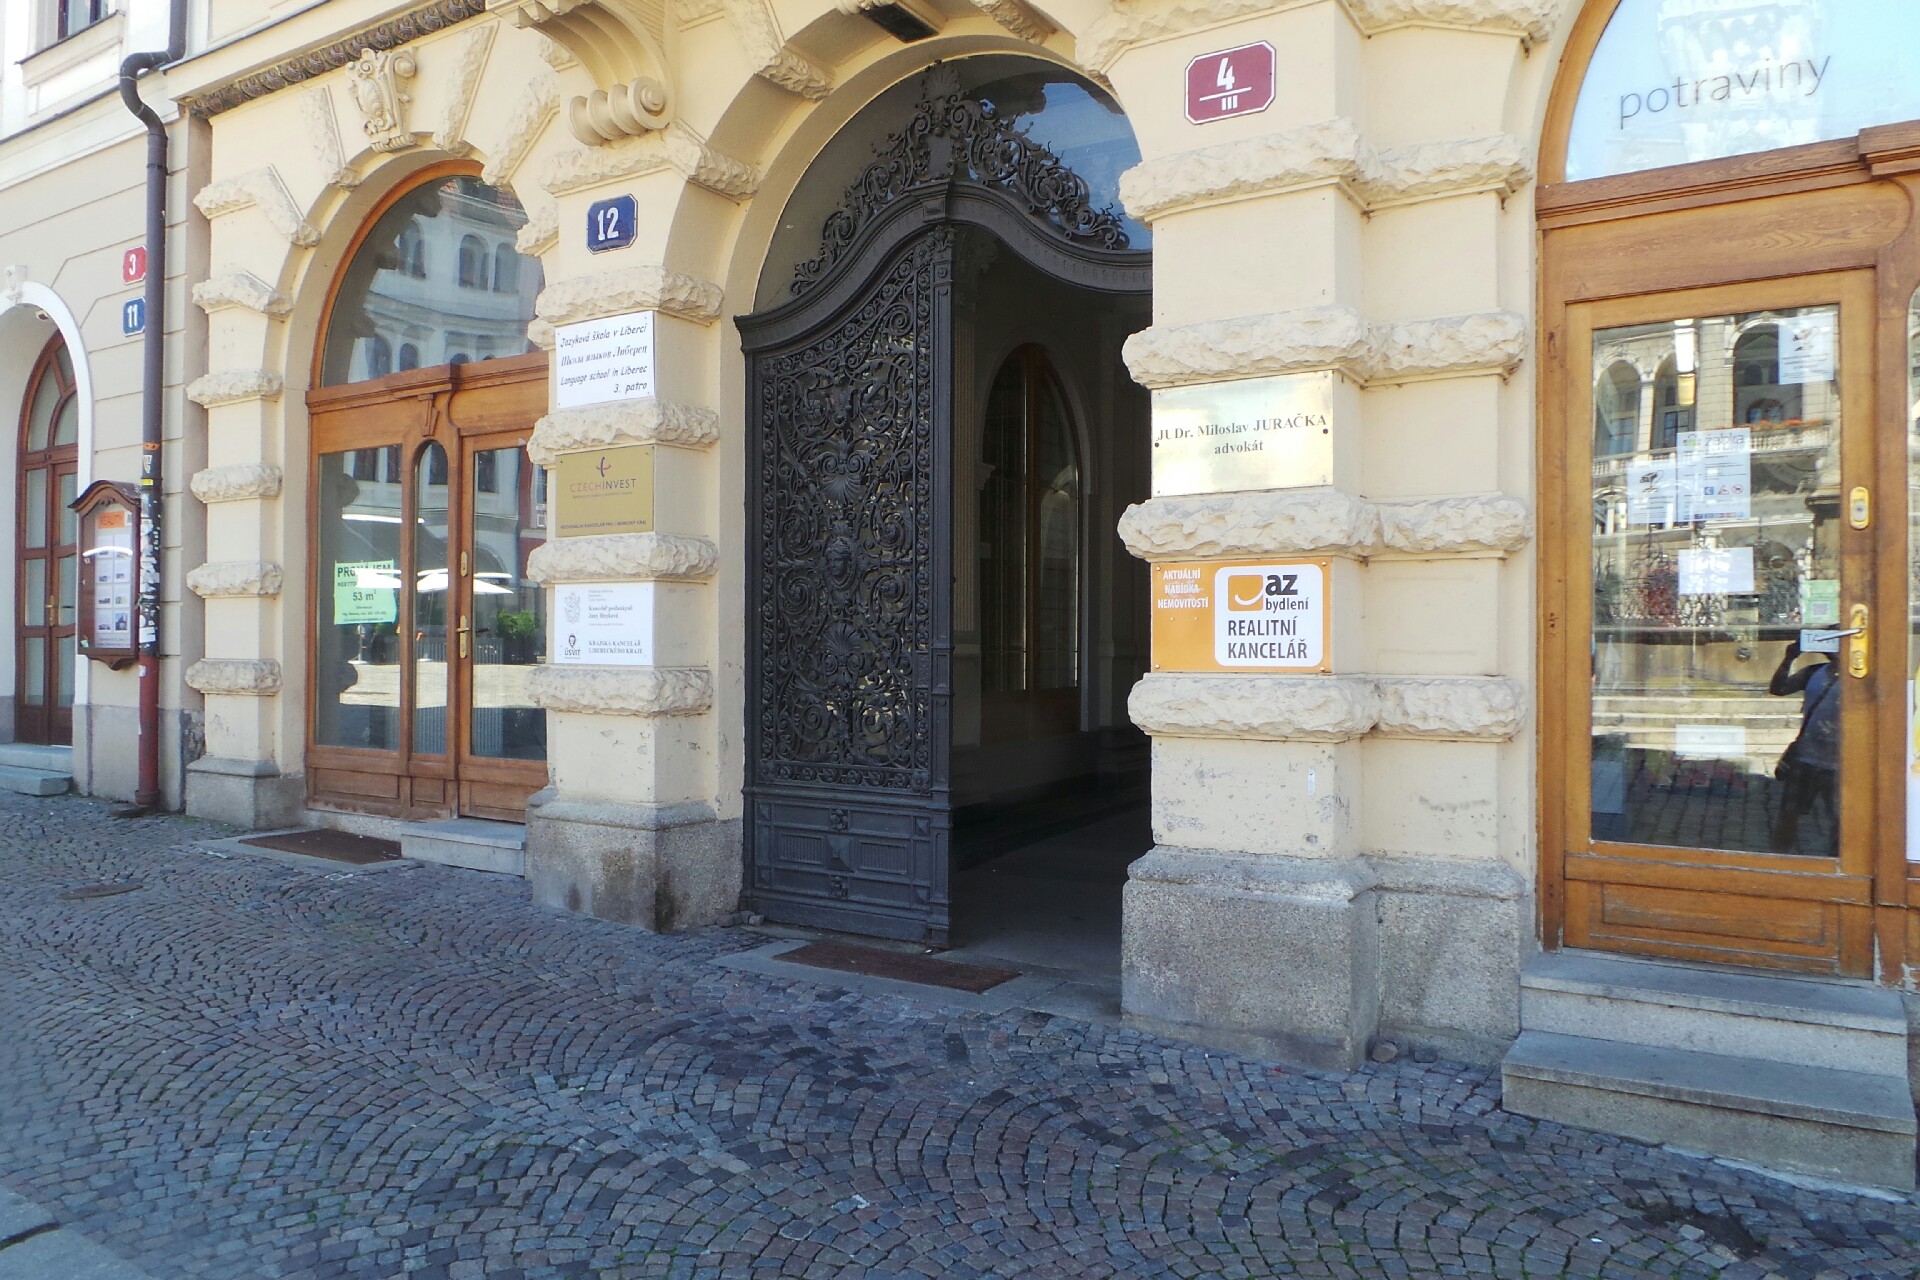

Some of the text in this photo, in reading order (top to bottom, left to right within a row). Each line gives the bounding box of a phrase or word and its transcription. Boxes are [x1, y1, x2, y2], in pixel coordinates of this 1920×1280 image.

[1217, 57, 1235, 90] 4
[1618, 55, 1831, 130] potraviny
[597, 206, 619, 241] 12
[128, 253, 136, 276] 3
[127, 304, 138, 328] 11
[560, 332, 590, 348] Jazyková
[592, 329, 610, 341] škola
[620, 323, 648, 336] Liberci
[560, 365, 648, 387] Language school in Liberec
[613, 381, 648, 395] 3. patro
[1198, 421, 1249, 437] Miloslav
[1253, 413, 1327, 432] JURAČKA
[1214, 440, 1264, 455] advokát
[569, 478, 637, 493] CZECHINVEST
[1163, 567, 1201, 580] AKTUÁLNÍ
[1164, 582, 1200, 594] NABÍDKA
[1265, 574, 1298, 596] az
[352, 591, 363, 601] 53
[1157, 596, 1209, 609] NEMOVITOSTÍ
[1265, 597, 1309, 613] bydlení
[1227, 616, 1298, 636] REALITNÍ
[1227, 639, 1308, 659] KANCELÁŘ
